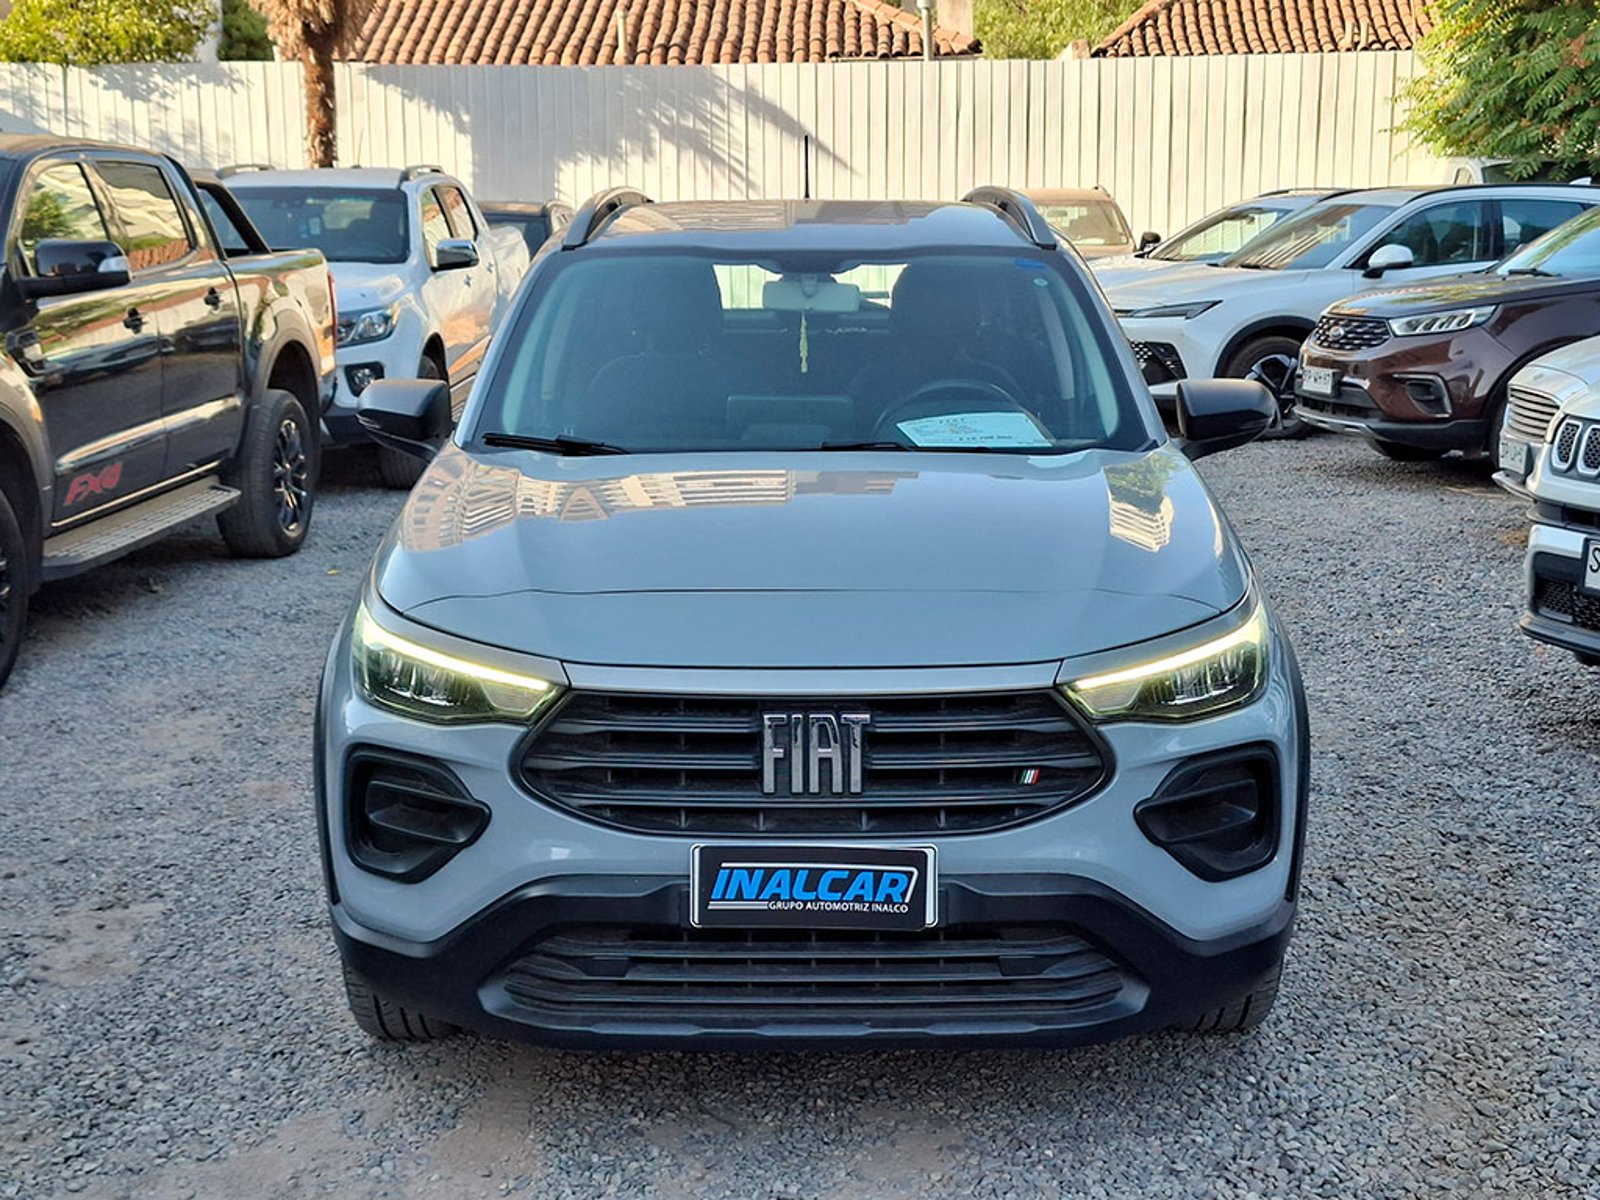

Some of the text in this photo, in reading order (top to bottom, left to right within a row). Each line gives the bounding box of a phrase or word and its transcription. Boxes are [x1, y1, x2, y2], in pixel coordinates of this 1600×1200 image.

[64, 462, 123, 506] FX4
[762, 713, 871, 793] FIAT
[710, 868, 909, 903] INALCAR
[768, 901, 909, 914] GRUPO AUTOMOTRIZ INALCO
